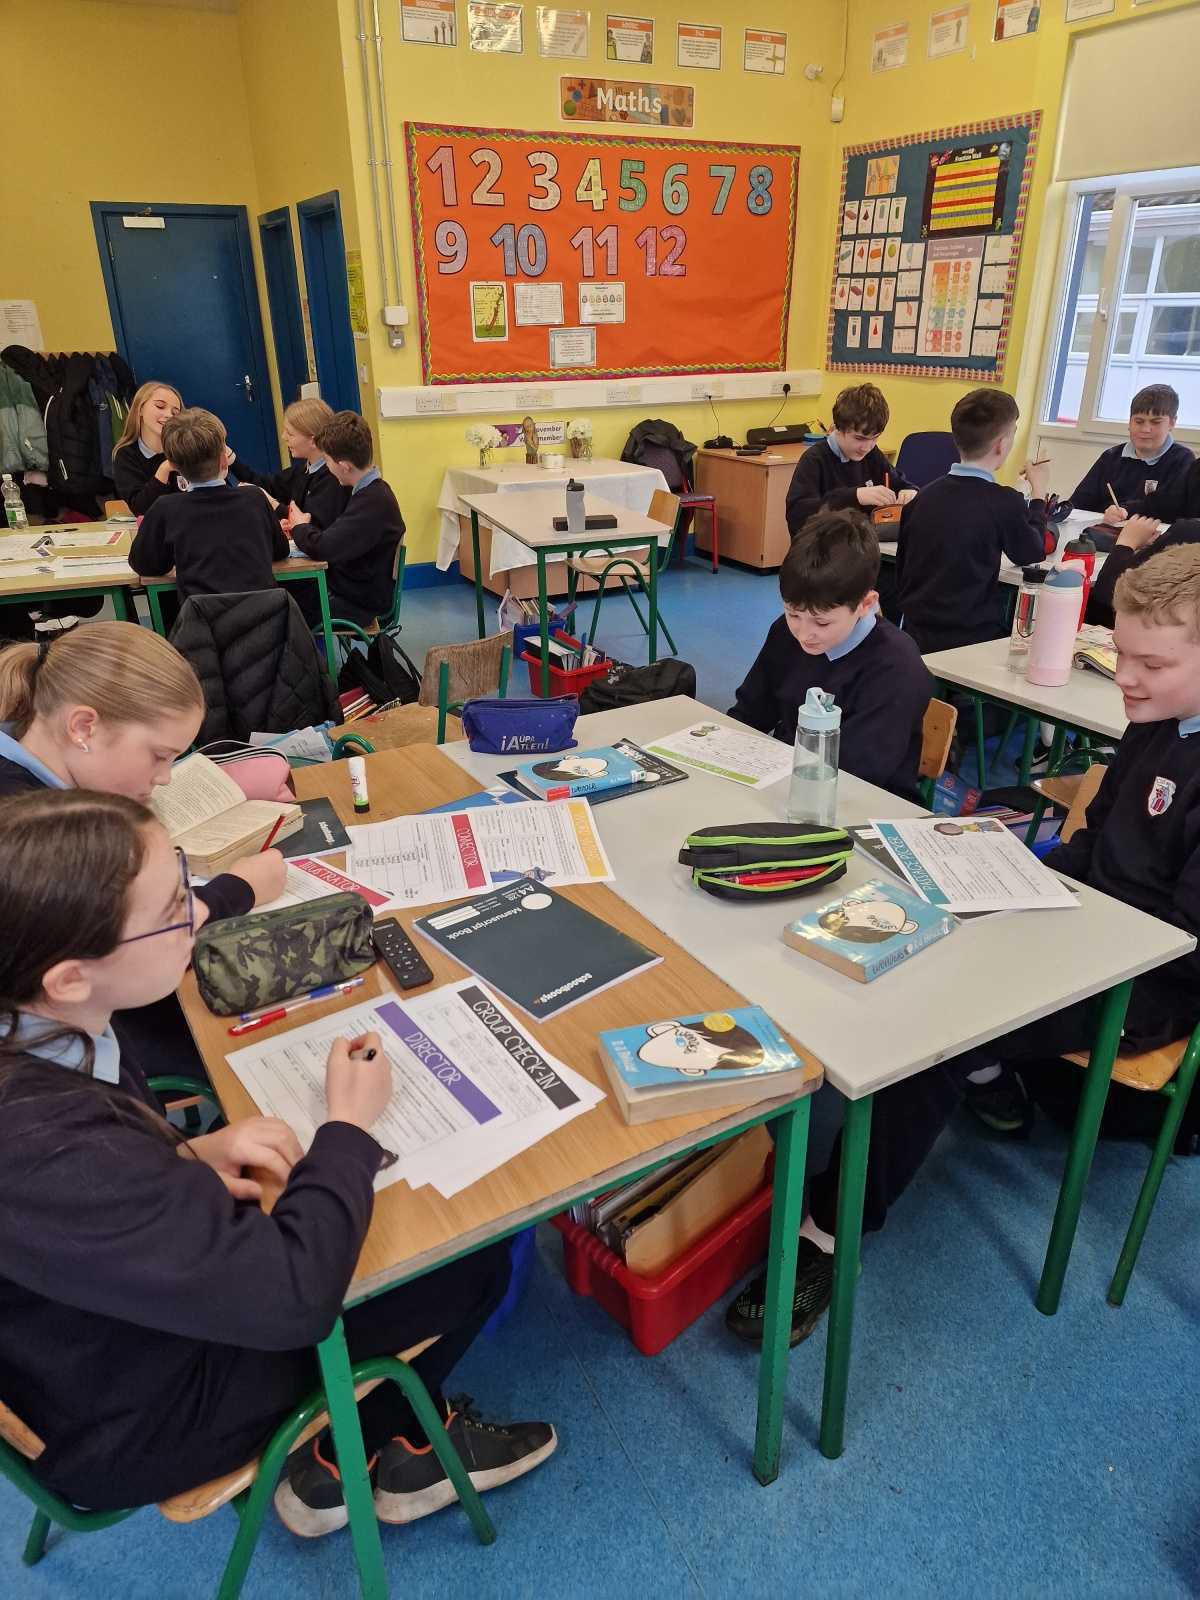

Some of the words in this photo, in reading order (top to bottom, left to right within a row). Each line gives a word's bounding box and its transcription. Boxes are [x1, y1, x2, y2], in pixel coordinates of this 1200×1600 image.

[596, 87, 662, 115] Maths
[426, 145, 459, 207] 1
[469, 147, 505, 207] 2
[526, 151, 561, 211] 3
[575, 157, 608, 212] 4
[618, 159, 648, 213] 5
[661, 163, 690, 216] 6
[708, 164, 737, 216] 7
[746, 165, 774, 217] 8
[434, 220, 469, 275] 9
[490, 223, 548, 278] 10
[569, 224, 619, 278] 11
[634, 224, 688, 277] 12
[535, 425, 562, 433] ovember
[446, 926, 474, 940] Book
[473, 906, 523, 931] Manuscript
[403, 1031, 462, 1087] DIRECTOR
[472, 1000, 514, 1036] GROUP
[503, 1034, 561, 1091] CHECK-IN
